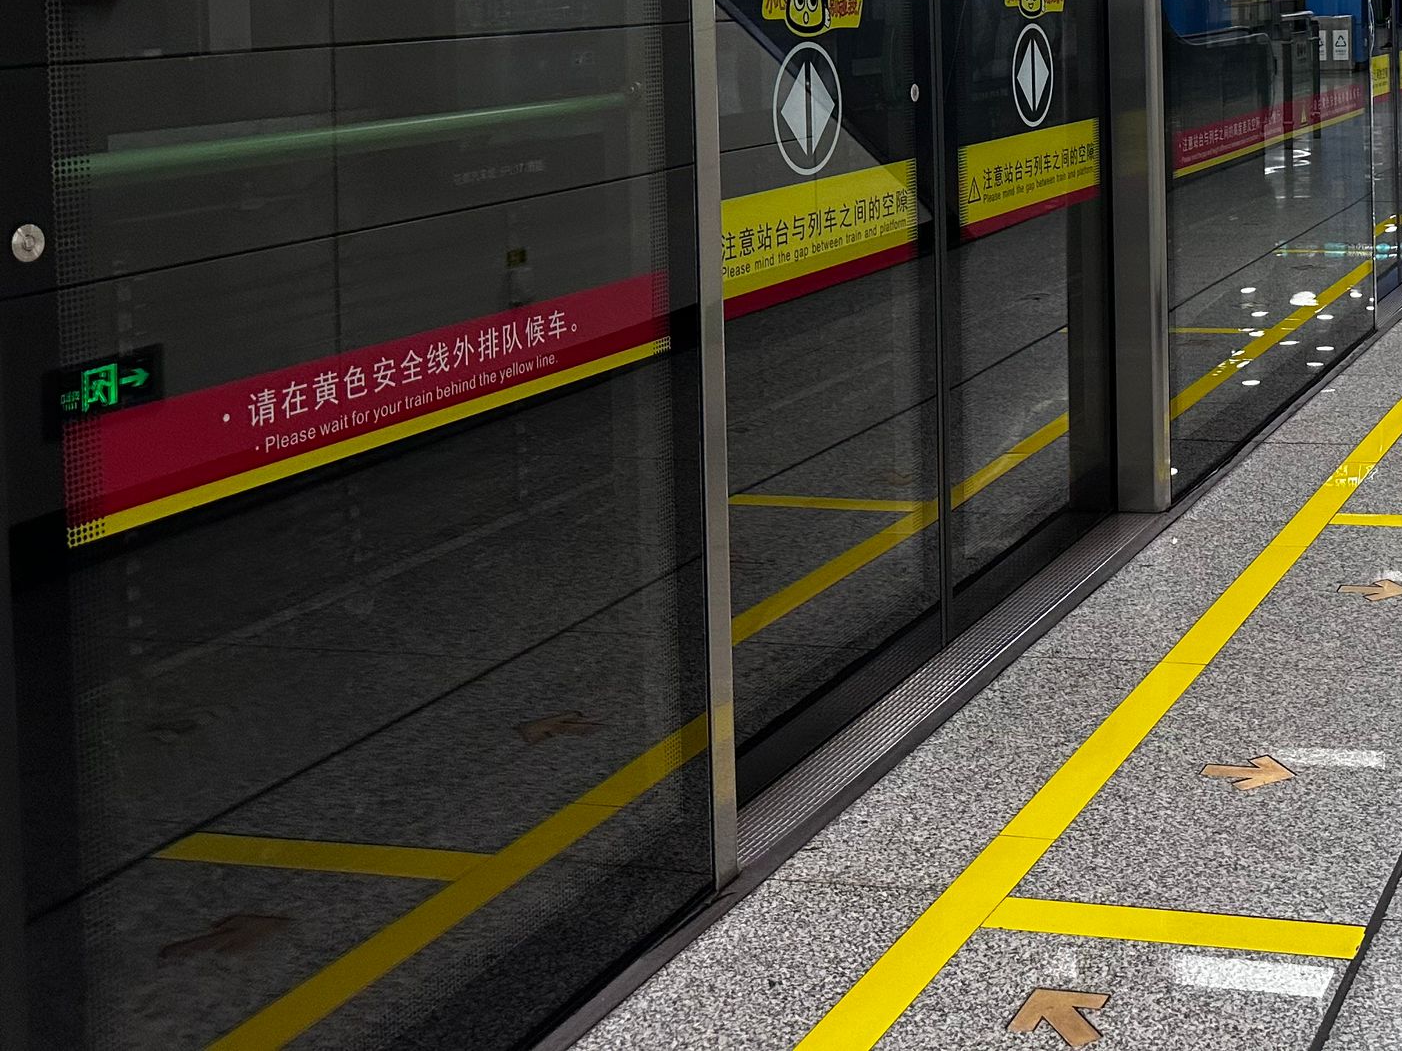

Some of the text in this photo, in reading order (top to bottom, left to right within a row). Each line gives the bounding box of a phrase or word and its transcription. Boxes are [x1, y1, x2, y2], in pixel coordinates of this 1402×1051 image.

[721, 188, 908, 262] 注意站台与列车之间的空隙
[722, 262, 750, 277] Please
[755, 256, 774, 270] mind
[778, 250, 791, 262] the
[794, 246, 809, 261] gap
[811, 236, 843, 253] between
[846, 232, 861, 243] train
[865, 226, 878, 238] and
[247, 310, 578, 427] 请在黄色安全线外排队候车。
[265, 353, 558, 452] Please wait for your train behind the yellow line.
